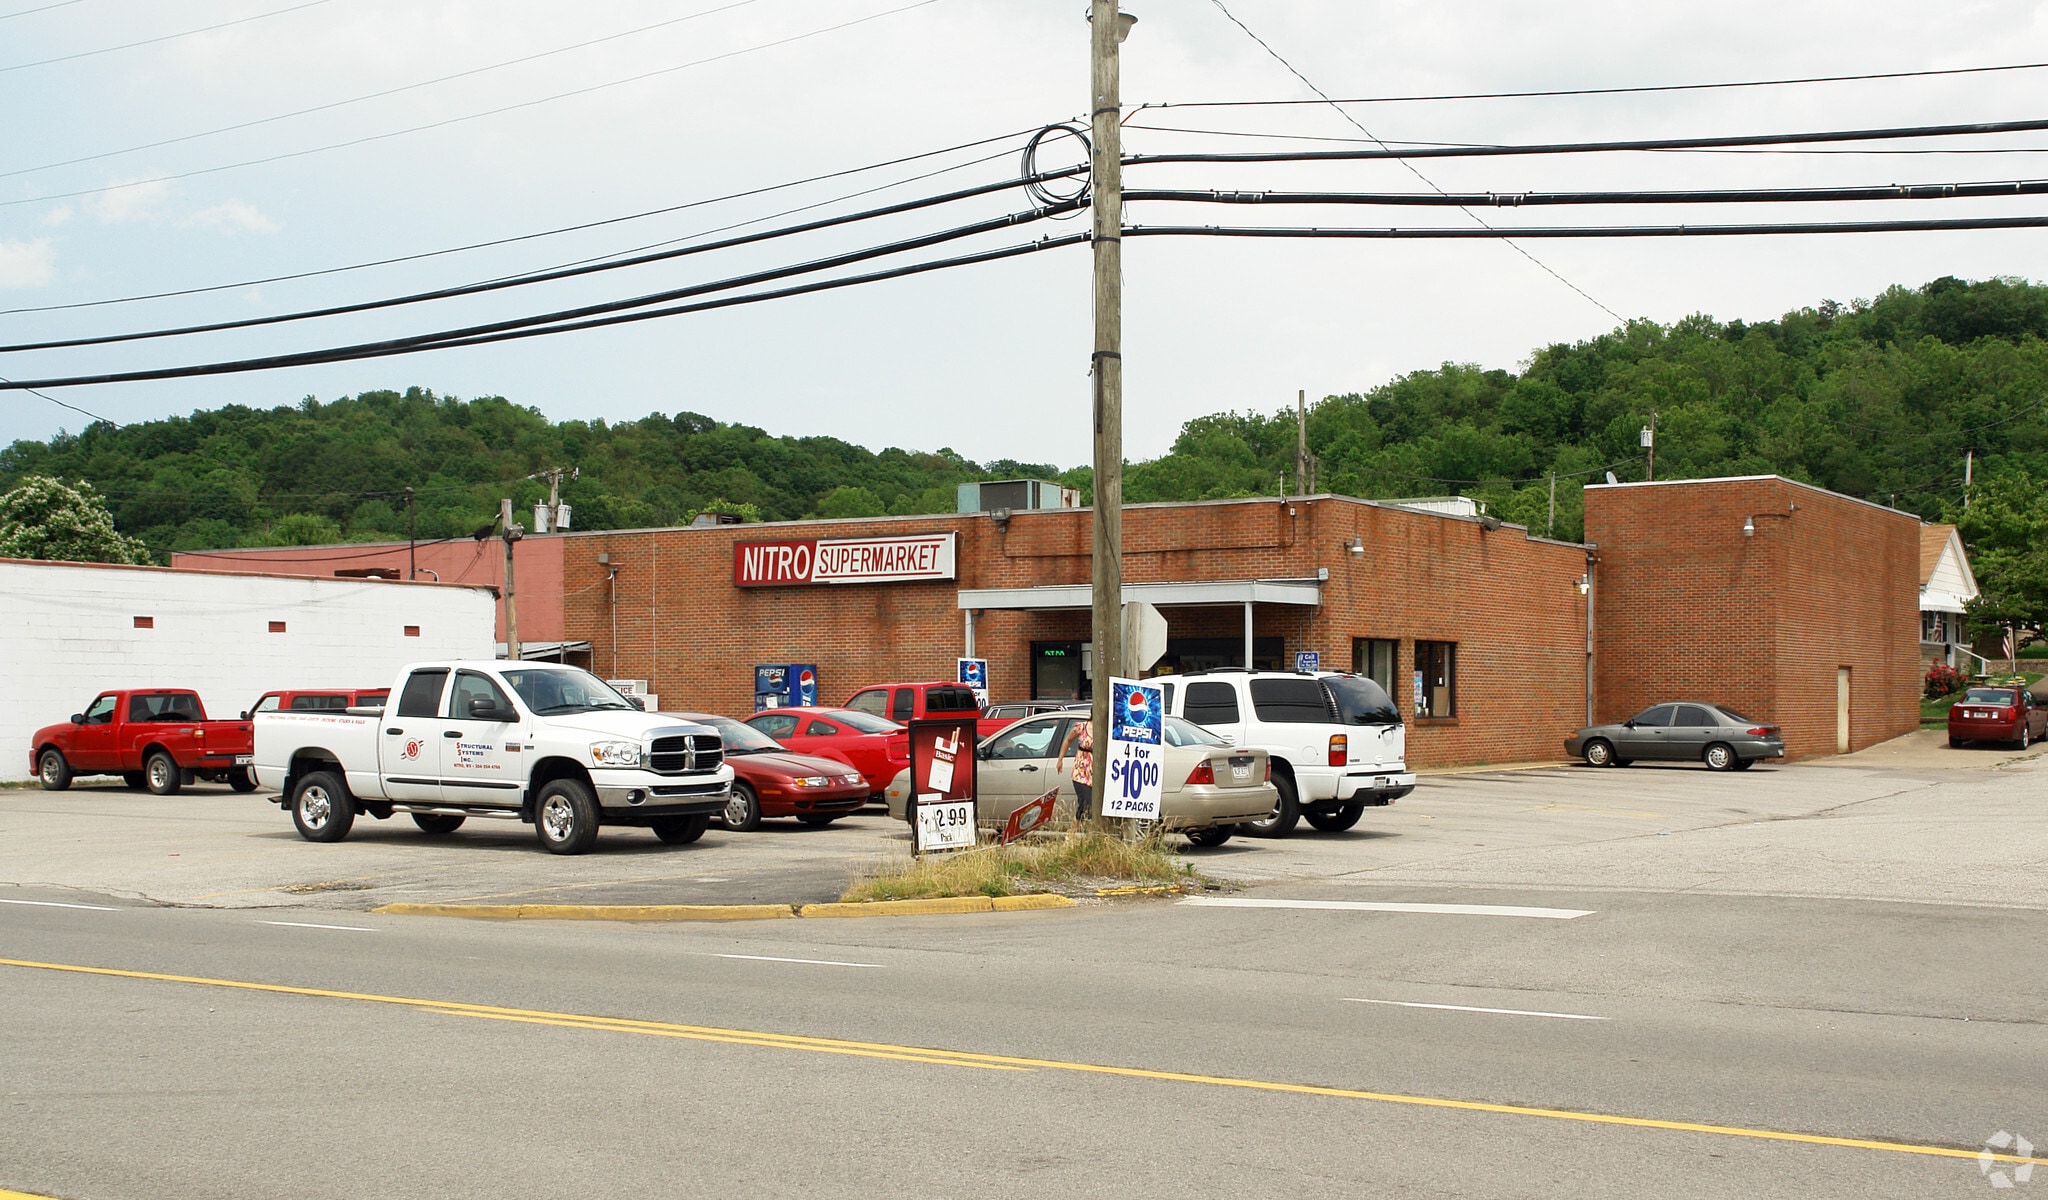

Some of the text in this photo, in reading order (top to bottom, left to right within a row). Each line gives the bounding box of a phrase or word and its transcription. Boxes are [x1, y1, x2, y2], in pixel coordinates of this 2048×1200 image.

[743, 544, 941, 581] NITRO SUPERMARKET
[758, 668, 786, 677] PEPSI
[1121, 726, 1153, 740] PEPSI
[456, 742, 494, 751] STRUCTURAL
[1124, 743, 1151, 759] 4 for
[935, 750, 954, 762] Basic
[1110, 799, 1155, 813] 12 PACKS
